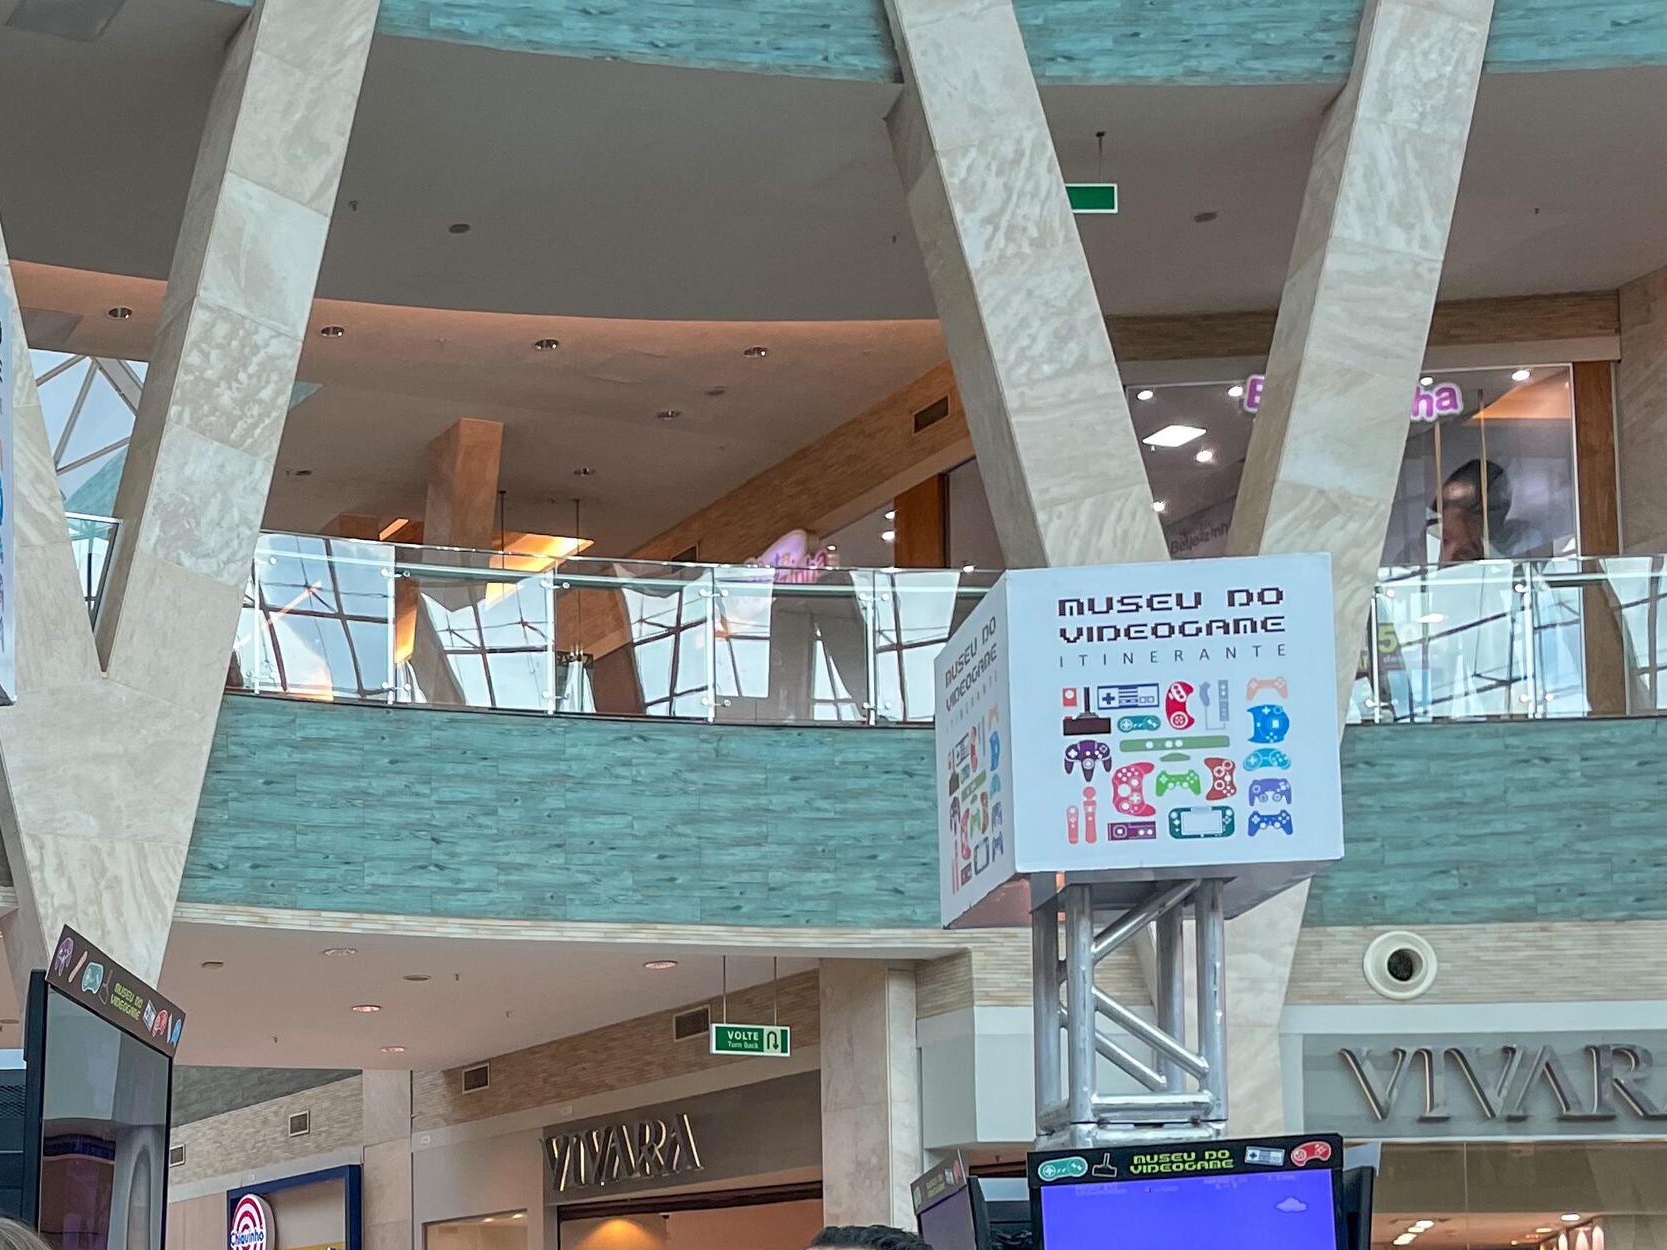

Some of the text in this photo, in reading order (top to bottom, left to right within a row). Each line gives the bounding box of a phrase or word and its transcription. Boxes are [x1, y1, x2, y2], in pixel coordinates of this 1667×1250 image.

[1057, 586, 1285, 617] MUSEU DO
[982, 615, 997, 645] DO
[1058, 615, 1286, 643] VIDEOGAME
[1058, 643, 1287, 668] ITINERANTE
[727, 1030, 759, 1041] VOLTE
[727, 1041, 743, 1049] Turn
[539, 1113, 705, 1192] VIVARA
[1132, 1149, 1230, 1165] MUSEU DO
[1129, 1159, 1235, 1174] VIDEOGAME
